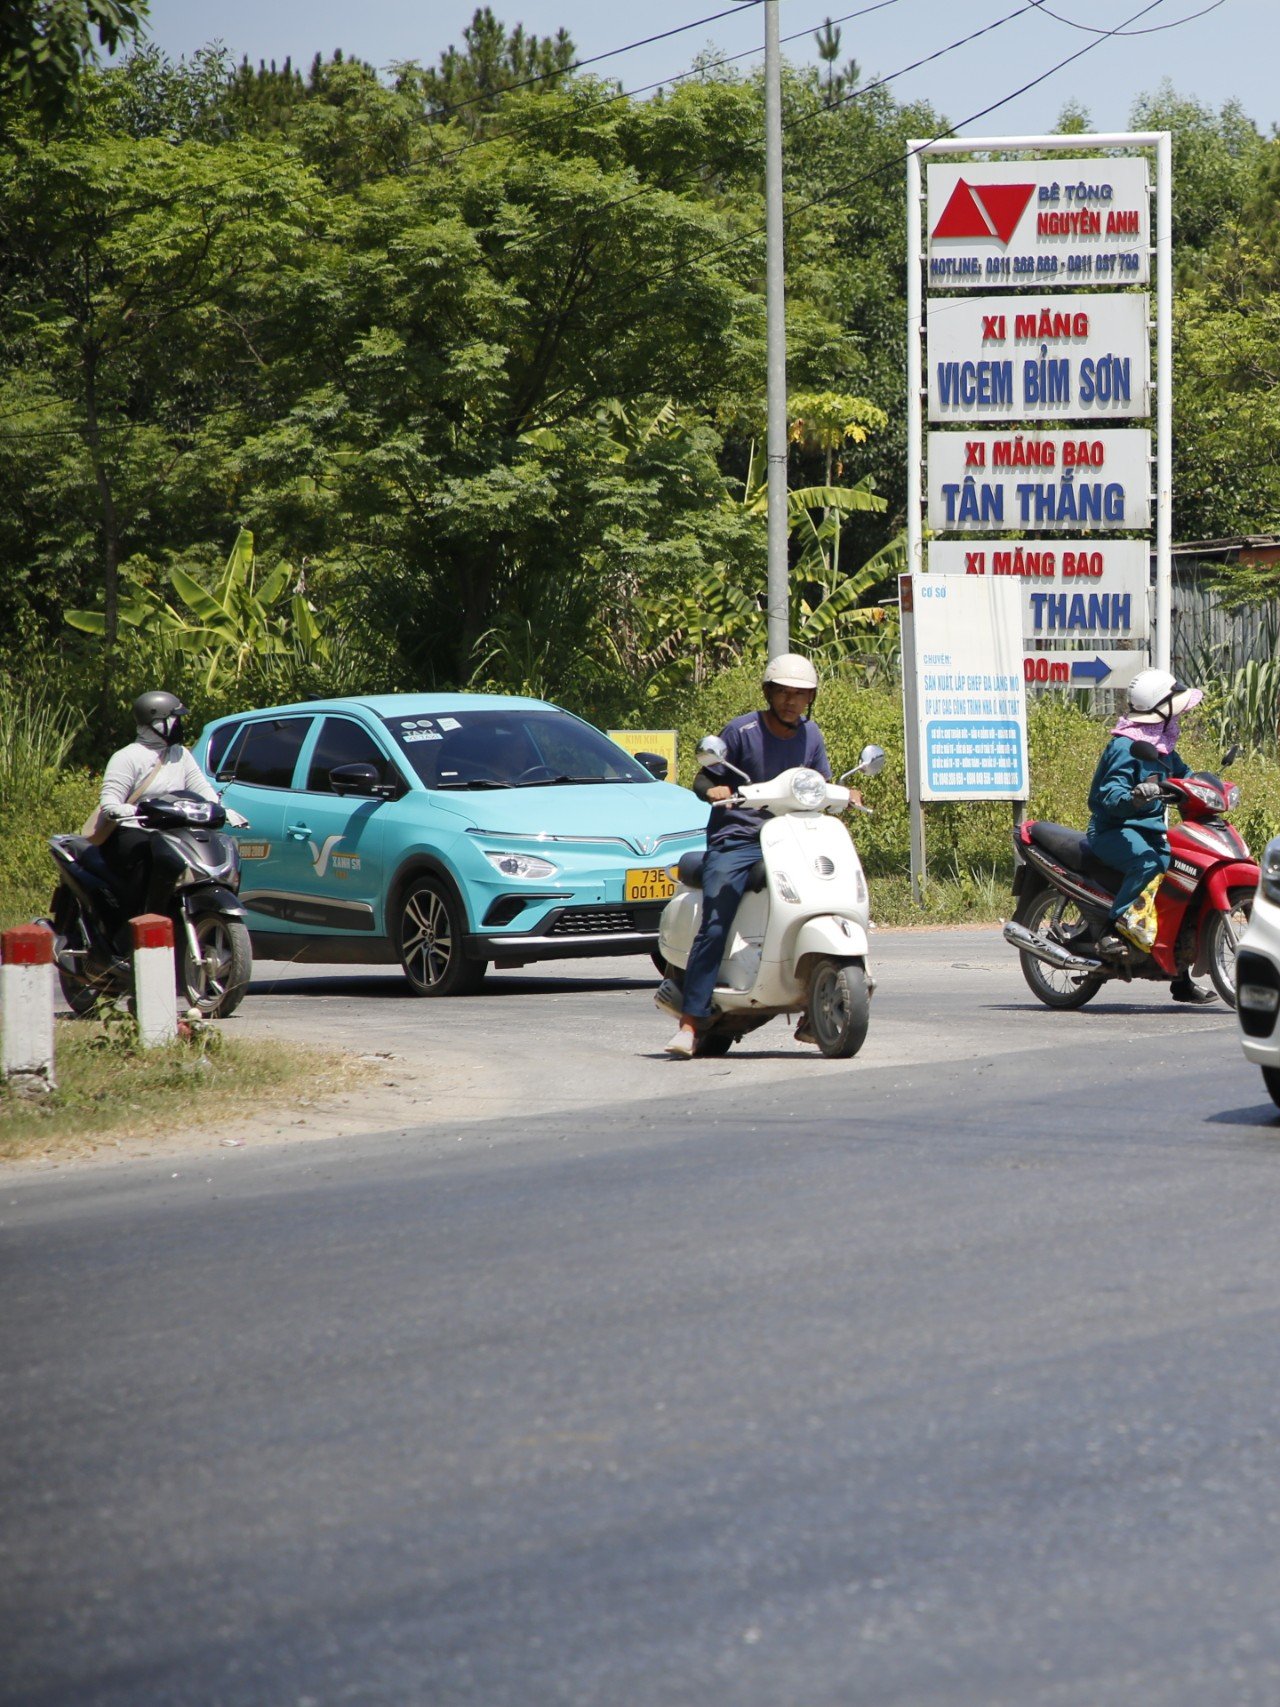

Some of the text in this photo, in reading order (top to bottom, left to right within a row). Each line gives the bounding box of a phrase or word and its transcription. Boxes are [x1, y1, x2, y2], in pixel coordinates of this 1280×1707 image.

[1038, 181, 1113, 200] BÊ TÔNG
[1037, 207, 1139, 235] NGUYÊN ANH
[931, 257, 982, 275] HOTLINE:
[982, 308, 1089, 339] XI MĂNG
[937, 344, 1131, 405] VICEM BỈM SƠN
[965, 436, 1104, 467] XI MĂNG BAO
[942, 468, 1125, 521] TÂN THẮNG
[966, 547, 1104, 577] XI MĂNG BAO
[1030, 593, 1131, 629] THANH
[642, 869, 665, 883] 73E
[1174, 859, 1197, 876] YAMAHA
[631, 883, 675, 899] 001.10
